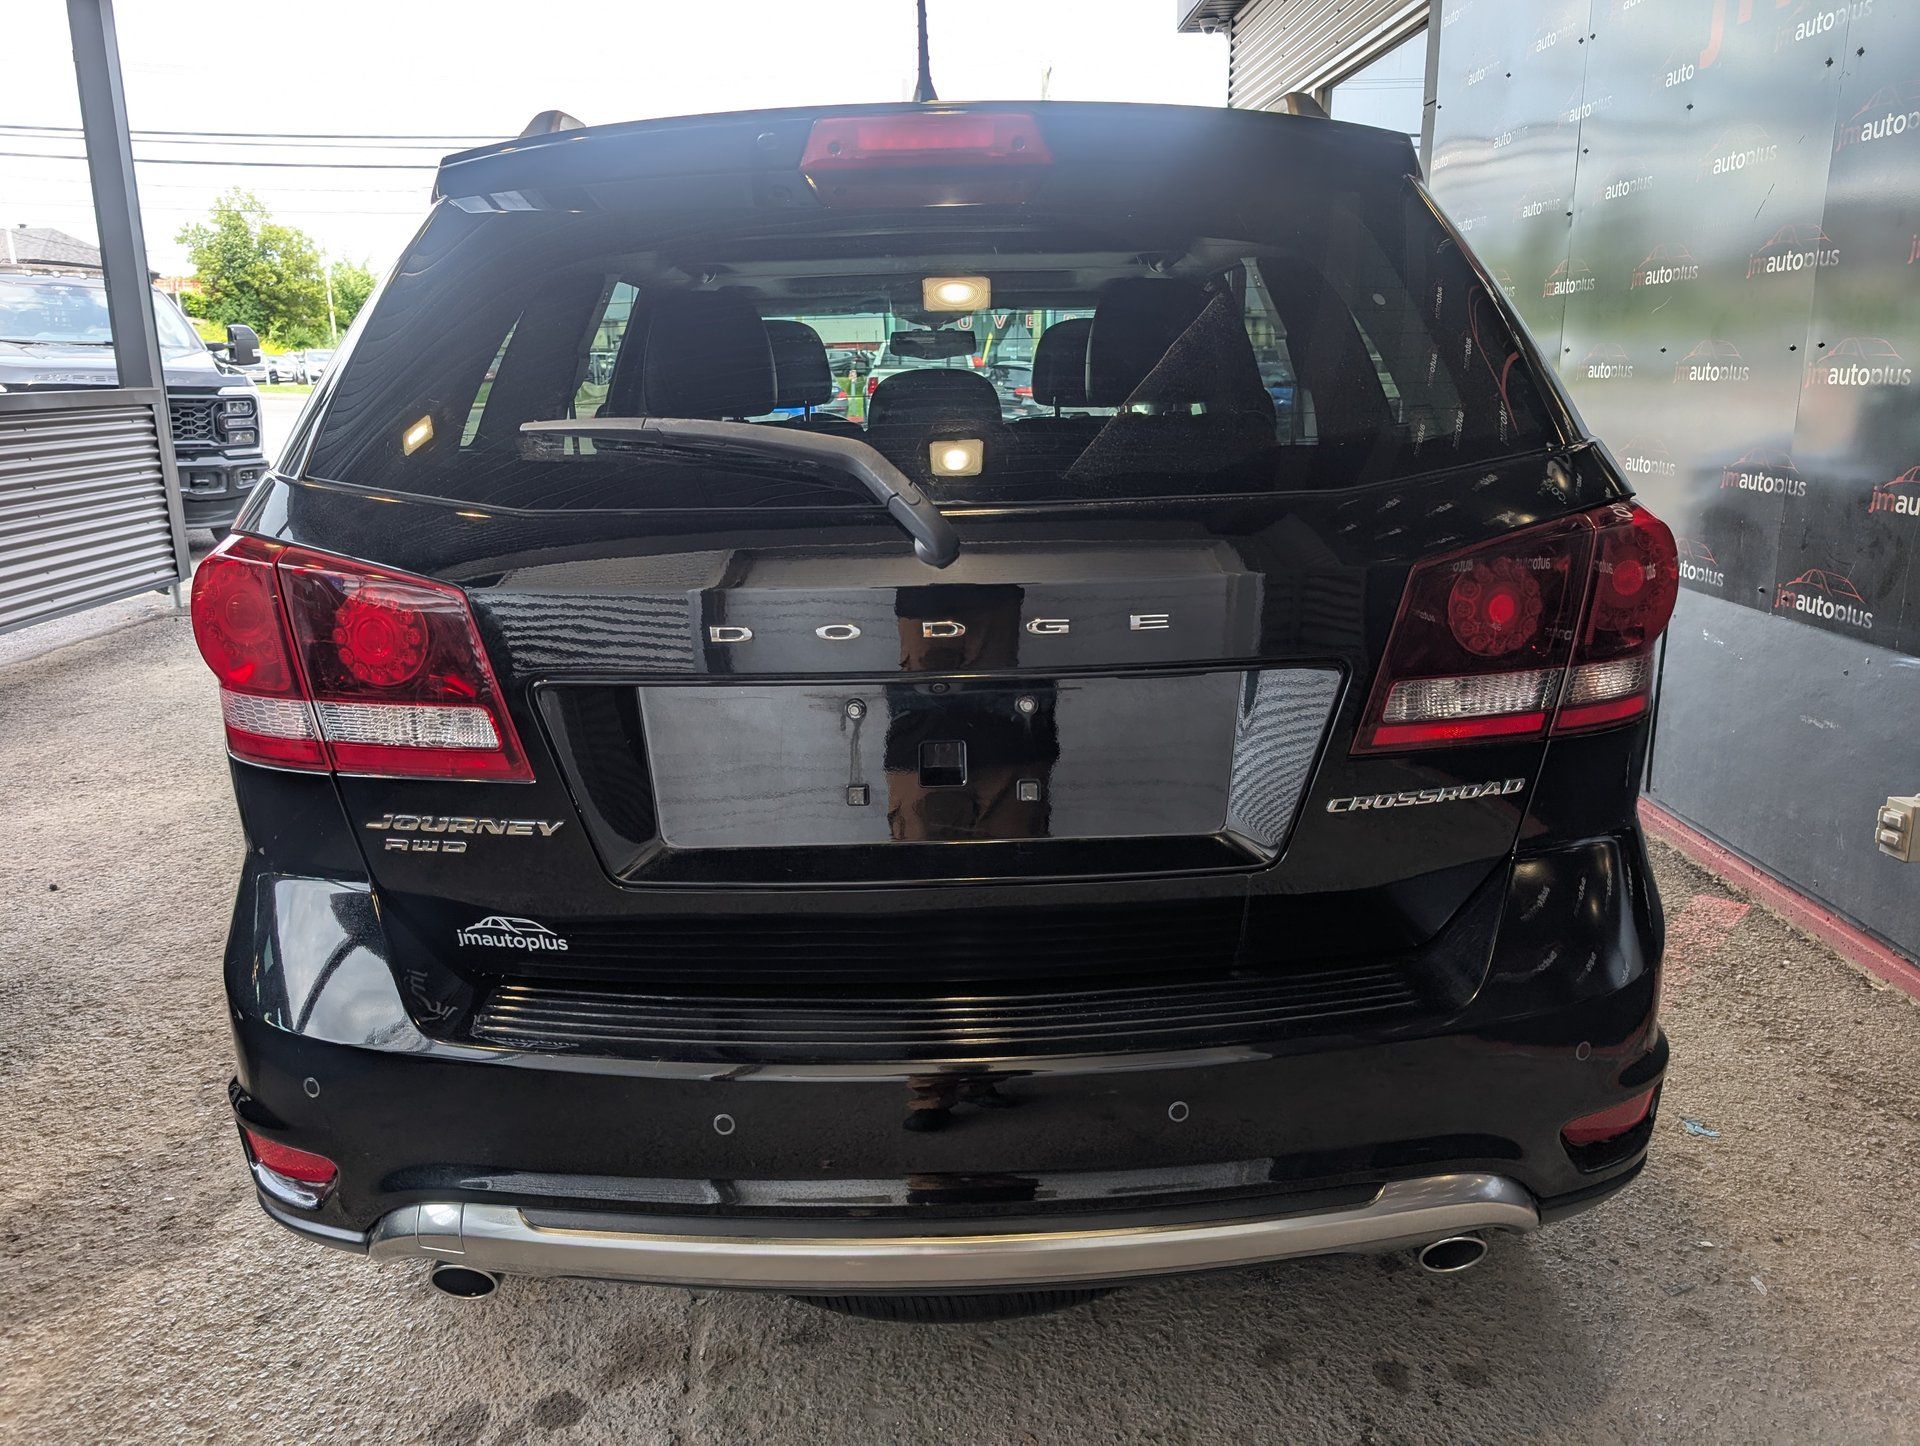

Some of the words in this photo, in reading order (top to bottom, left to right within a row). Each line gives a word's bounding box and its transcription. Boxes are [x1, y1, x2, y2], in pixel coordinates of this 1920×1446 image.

[1631, 263, 1699, 290] jmautoplus
[1746, 247, 1841, 279] jmautoplus
[1672, 360, 1751, 384] jmautoplus
[1804, 361, 1912, 390] jmautoplus
[1719, 465, 1807, 497] jmautoplus
[1774, 582, 1874, 630] jmautoplus
[709, 614, 1169, 643] DODGE
[1326, 777, 1526, 813] CROSSROAD
[365, 813, 566, 837] JOURNEY
[456, 929, 569, 952] jmautoplus
